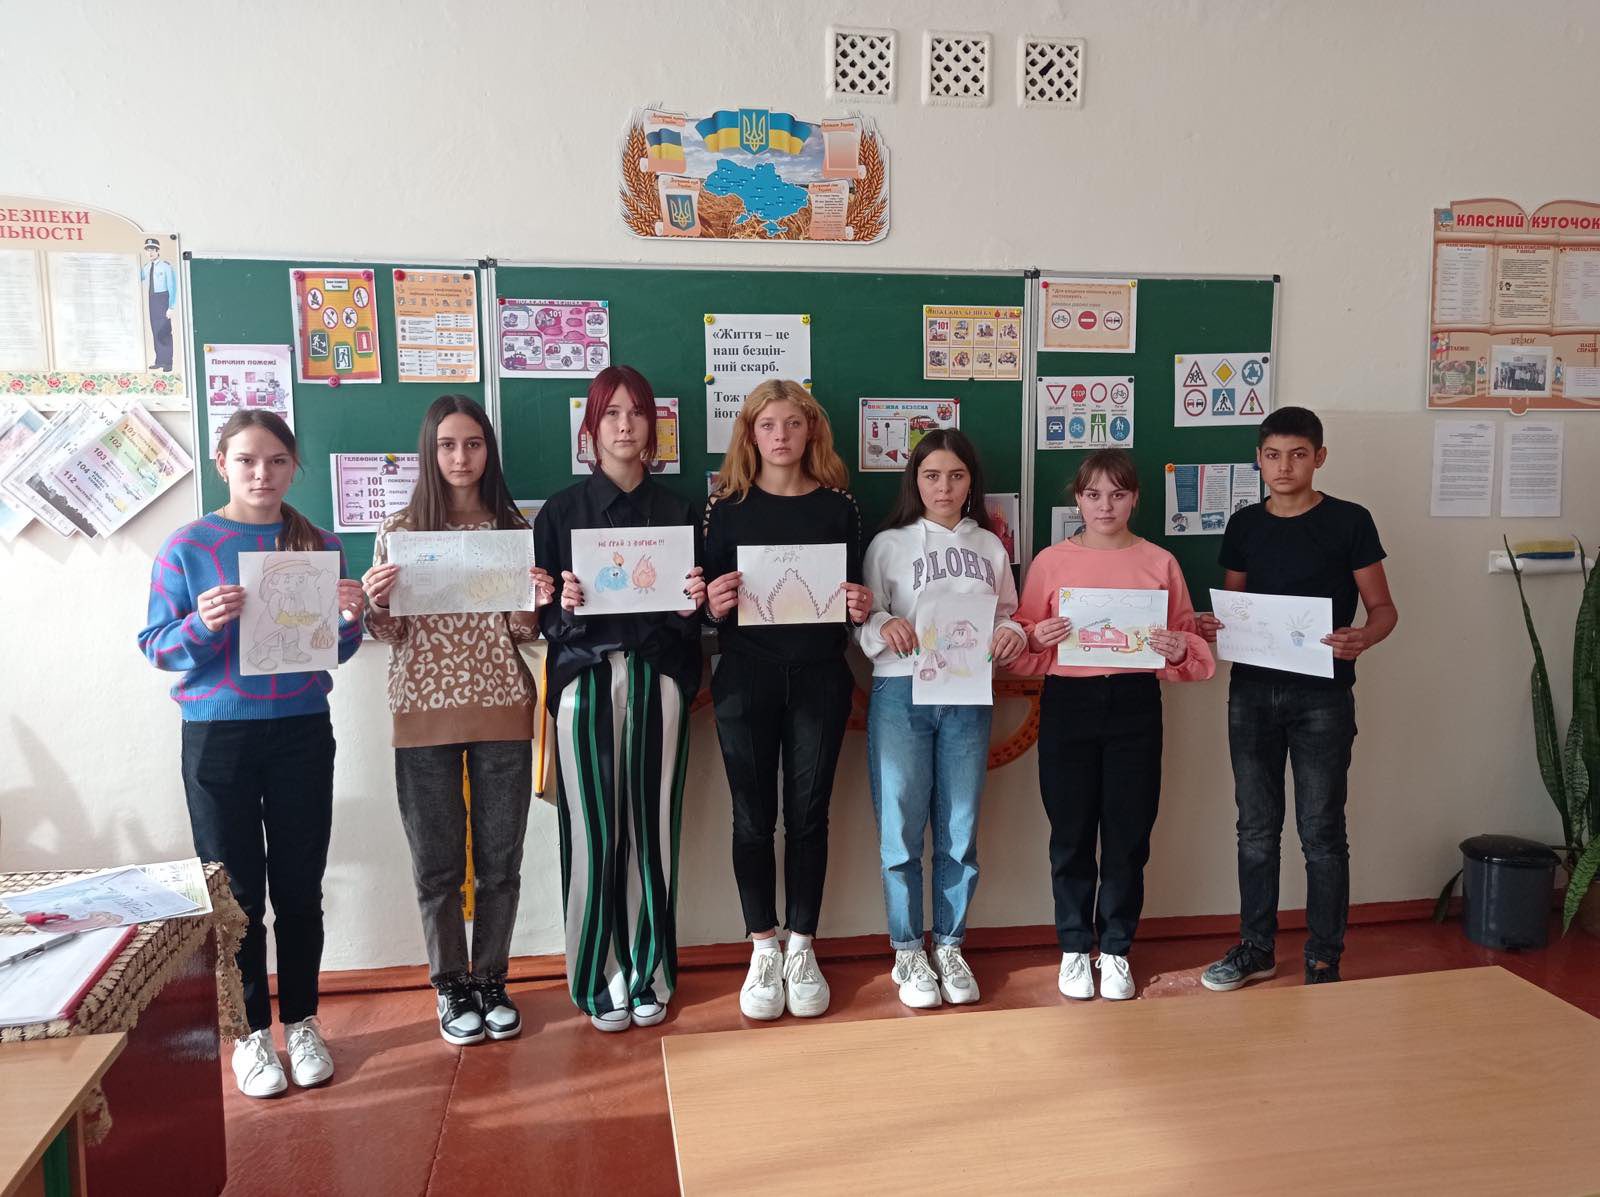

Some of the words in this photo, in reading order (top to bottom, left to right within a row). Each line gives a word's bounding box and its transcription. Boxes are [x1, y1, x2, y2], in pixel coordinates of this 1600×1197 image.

[1456, 212, 1524, 228] КЛАСНИЙ
[1531, 216, 1600, 230] КУТОЧОК
[548, 310, 562, 318] 101
[937, 321, 949, 331] 101
[712, 328, 762, 340] «Життя
[776, 331, 790, 341] це
[713, 347, 739, 356] наш
[743, 345, 786, 357] безцін-
[713, 361, 737, 372] ний
[740, 361, 779, 375] скарб.
[713, 391, 740, 403] Тож
[109, 435, 122, 449] 102
[94, 447, 107, 461] 103
[77, 460, 90, 474] 104
[63, 470, 78, 484] 112
[367, 476, 383, 486] 101
[367, 488, 386, 497] 102
[368, 499, 386, 508] 103
[369, 510, 387, 519] 104
[912, 546, 996, 590] ALOHA
